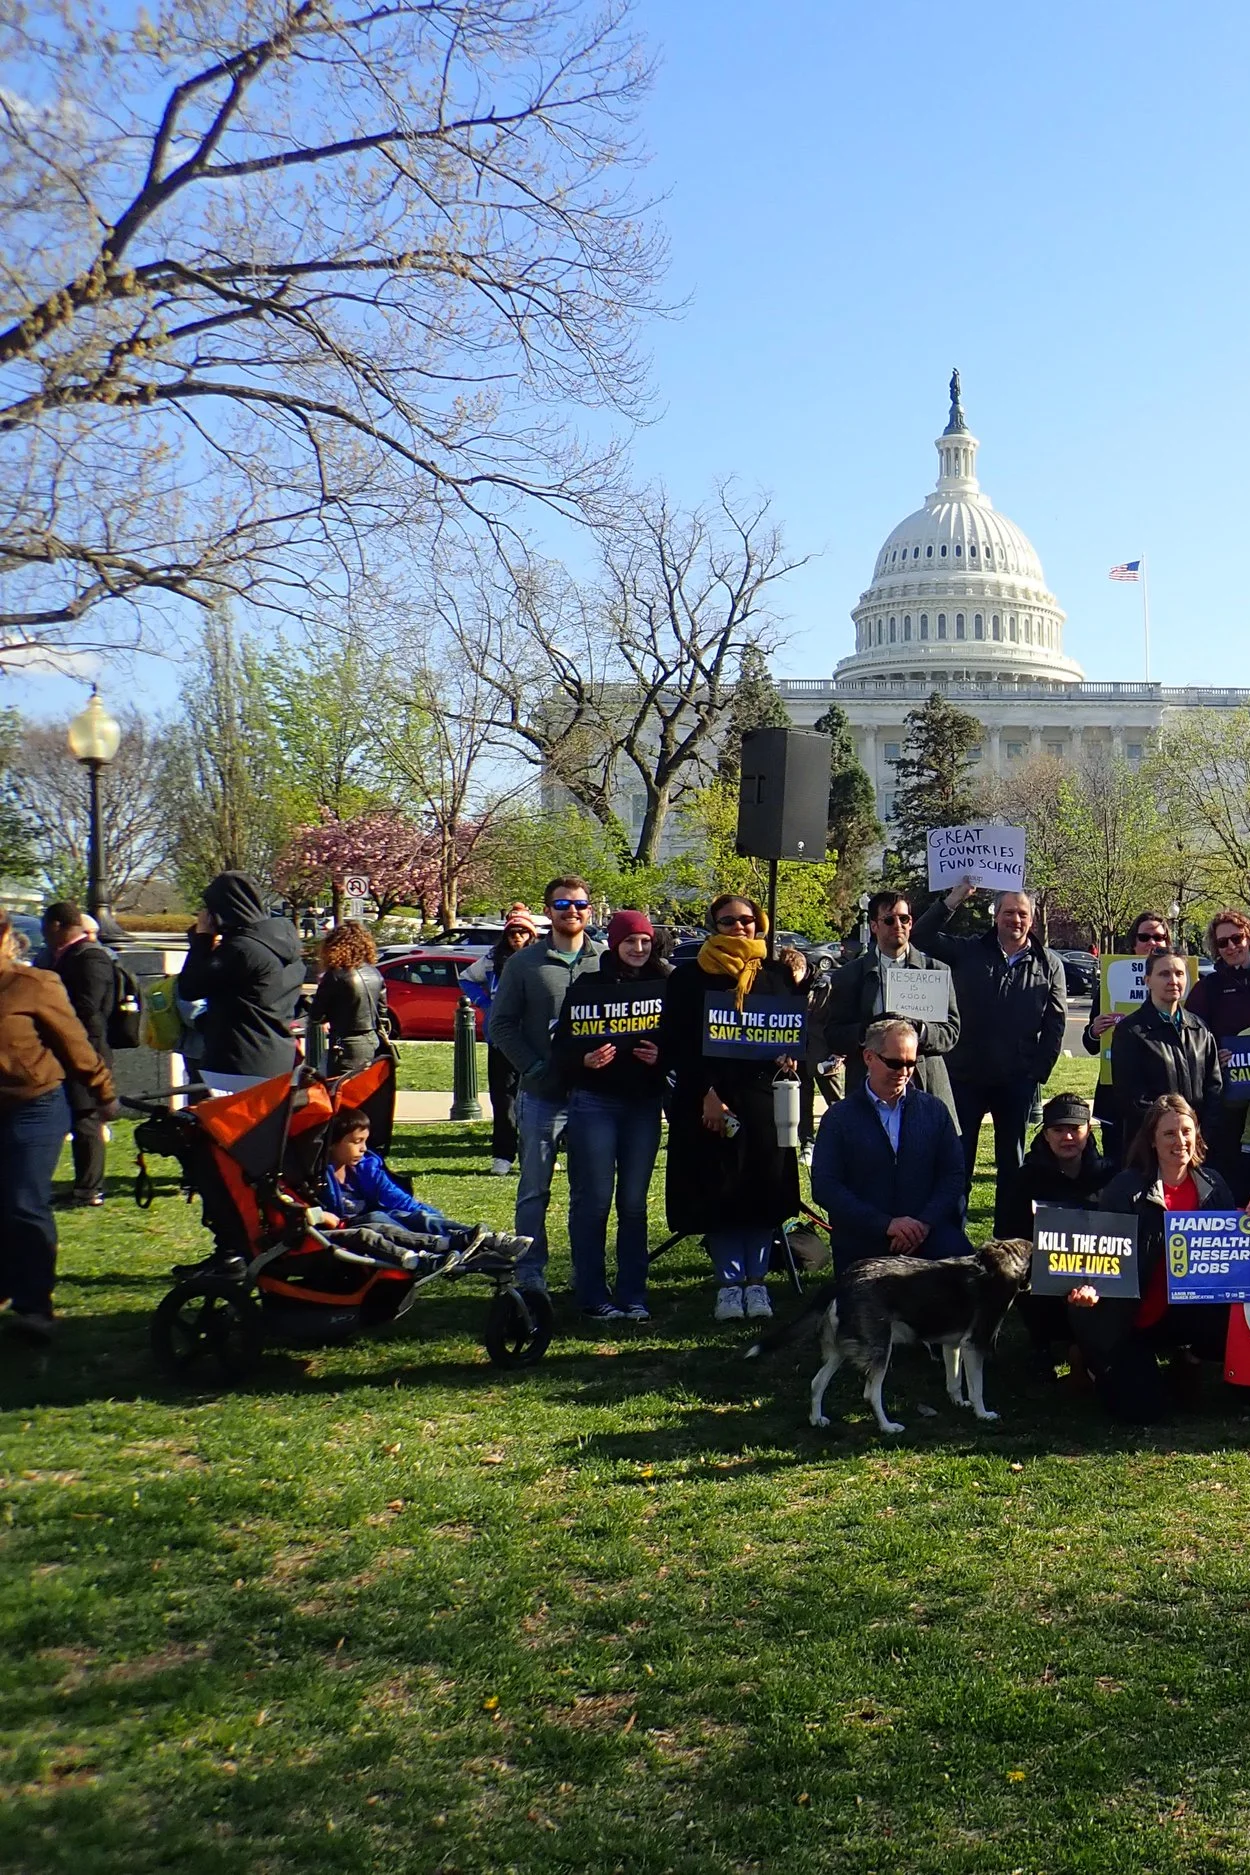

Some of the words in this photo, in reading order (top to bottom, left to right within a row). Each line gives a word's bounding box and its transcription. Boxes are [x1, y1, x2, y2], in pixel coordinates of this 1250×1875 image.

[929, 829, 983, 848] GREAT
[939, 845, 1014, 858] COUNTRIES
[940, 858, 974, 873] FUND
[979, 858, 1023, 876] SCIENCE
[1131, 962, 1144, 973] SO
[890, 971, 941, 984] RESEARCH
[1130, 990, 1144, 1000] AM
[570, 1004, 600, 1020] KILL
[604, 1003, 629, 1018] THE
[632, 998, 662, 1016] CUTS
[571, 1020, 606, 1036] SAVE
[609, 1014, 660, 1033] SCIENCE
[708, 1009, 737, 1026] KILL
[741, 1011, 765, 1027] THE
[769, 1013, 803, 1028] CUTS
[709, 1025, 743, 1042] SAVE
[746, 1028, 800, 1043] SCIENCE
[1170, 1217, 1237, 1232] HANDS
[1037, 1231, 1068, 1252] KILL
[1072, 1233, 1097, 1254] THE
[1099, 1235, 1132, 1257] CUTS
[1049, 1252, 1083, 1274] SAVE
[1084, 1254, 1120, 1276] LIVES
[1172, 1237, 1185, 1273] OUR
[1189, 1263, 1230, 1274] JOBS
